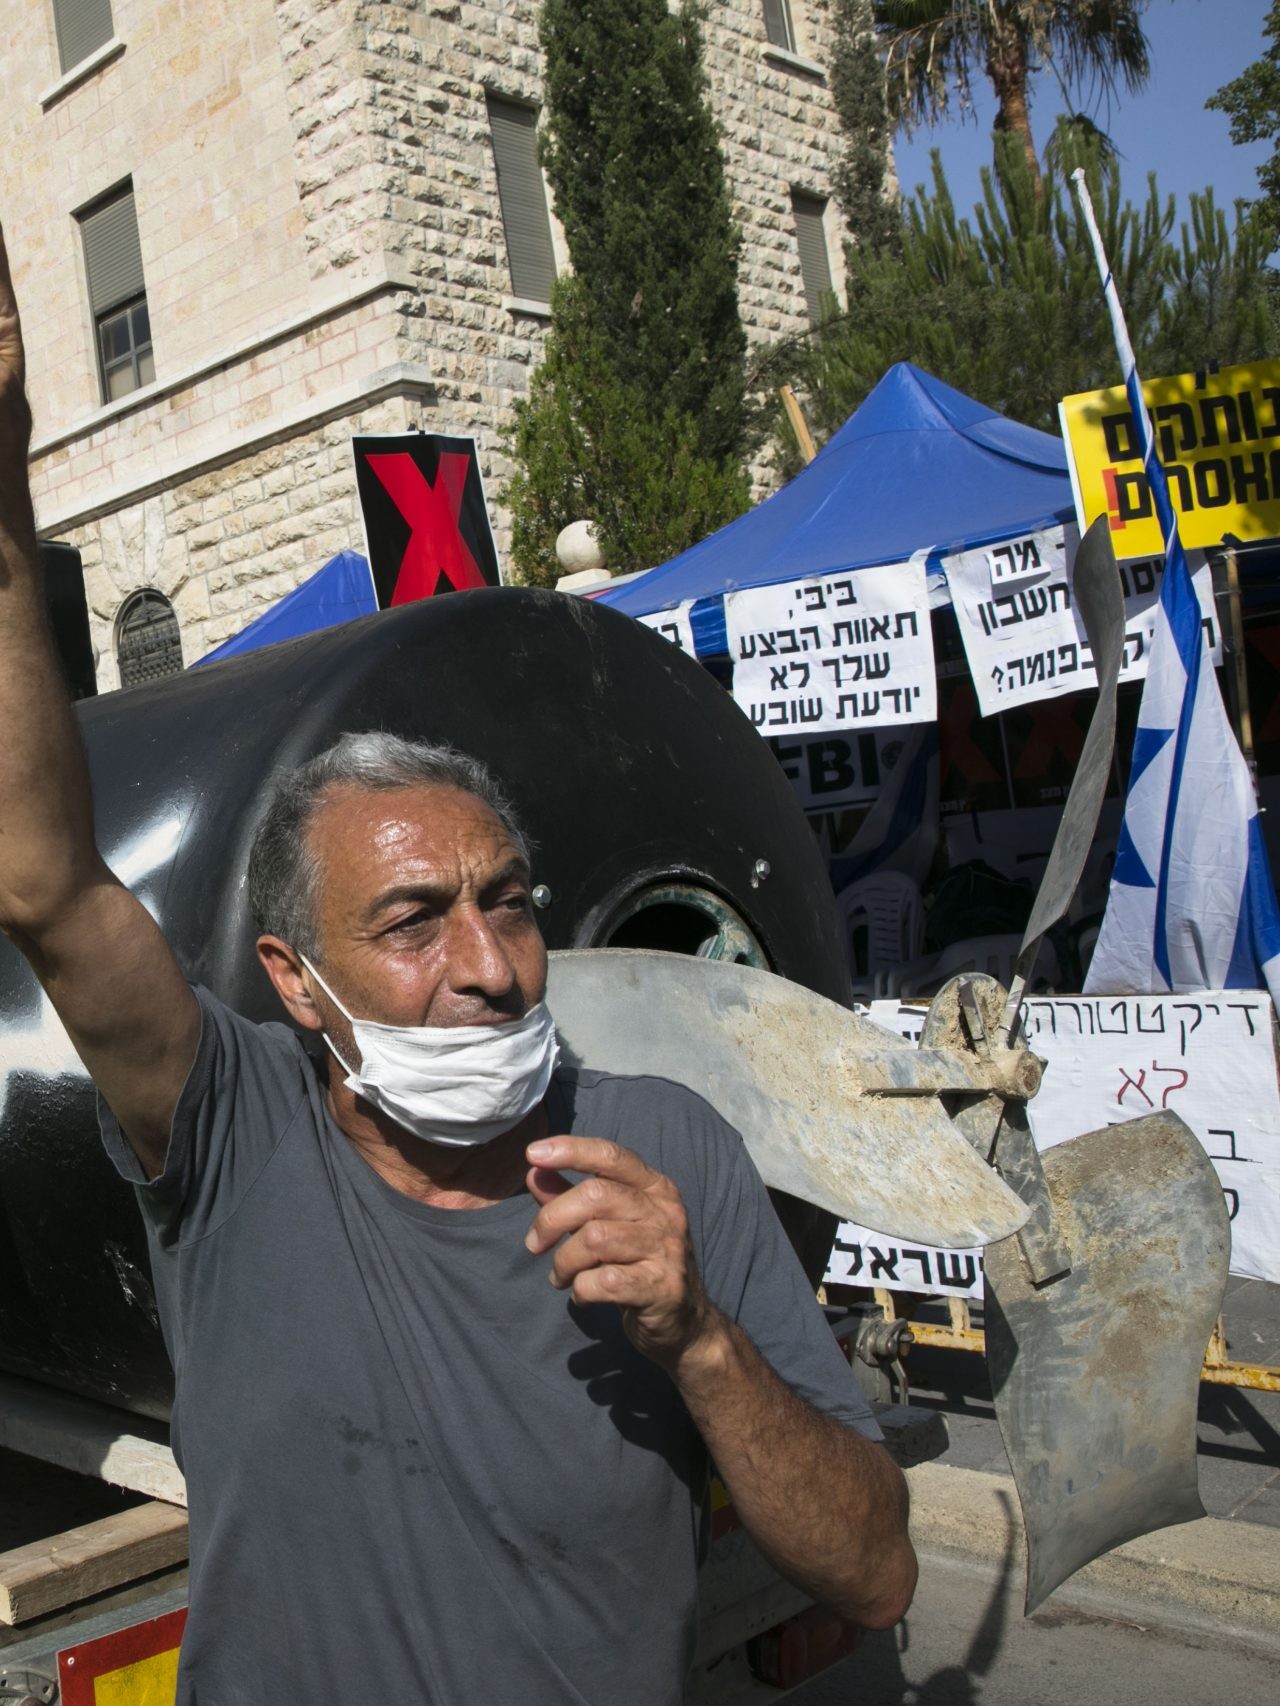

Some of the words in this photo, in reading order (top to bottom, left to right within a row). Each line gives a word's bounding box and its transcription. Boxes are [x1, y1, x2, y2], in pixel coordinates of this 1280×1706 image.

[992, 539, 1041, 577] מה
[977, 582, 1071, 636] חשבון
[740, 626, 821, 660] הבצע
[832, 611, 919, 648] תאוות
[769, 661, 811, 691] לא
[822, 652, 891, 688] שלך
[750, 695, 823, 727] שובע
[835, 686, 921, 719] יודעת
[1117, 1059, 1189, 1109] לא
